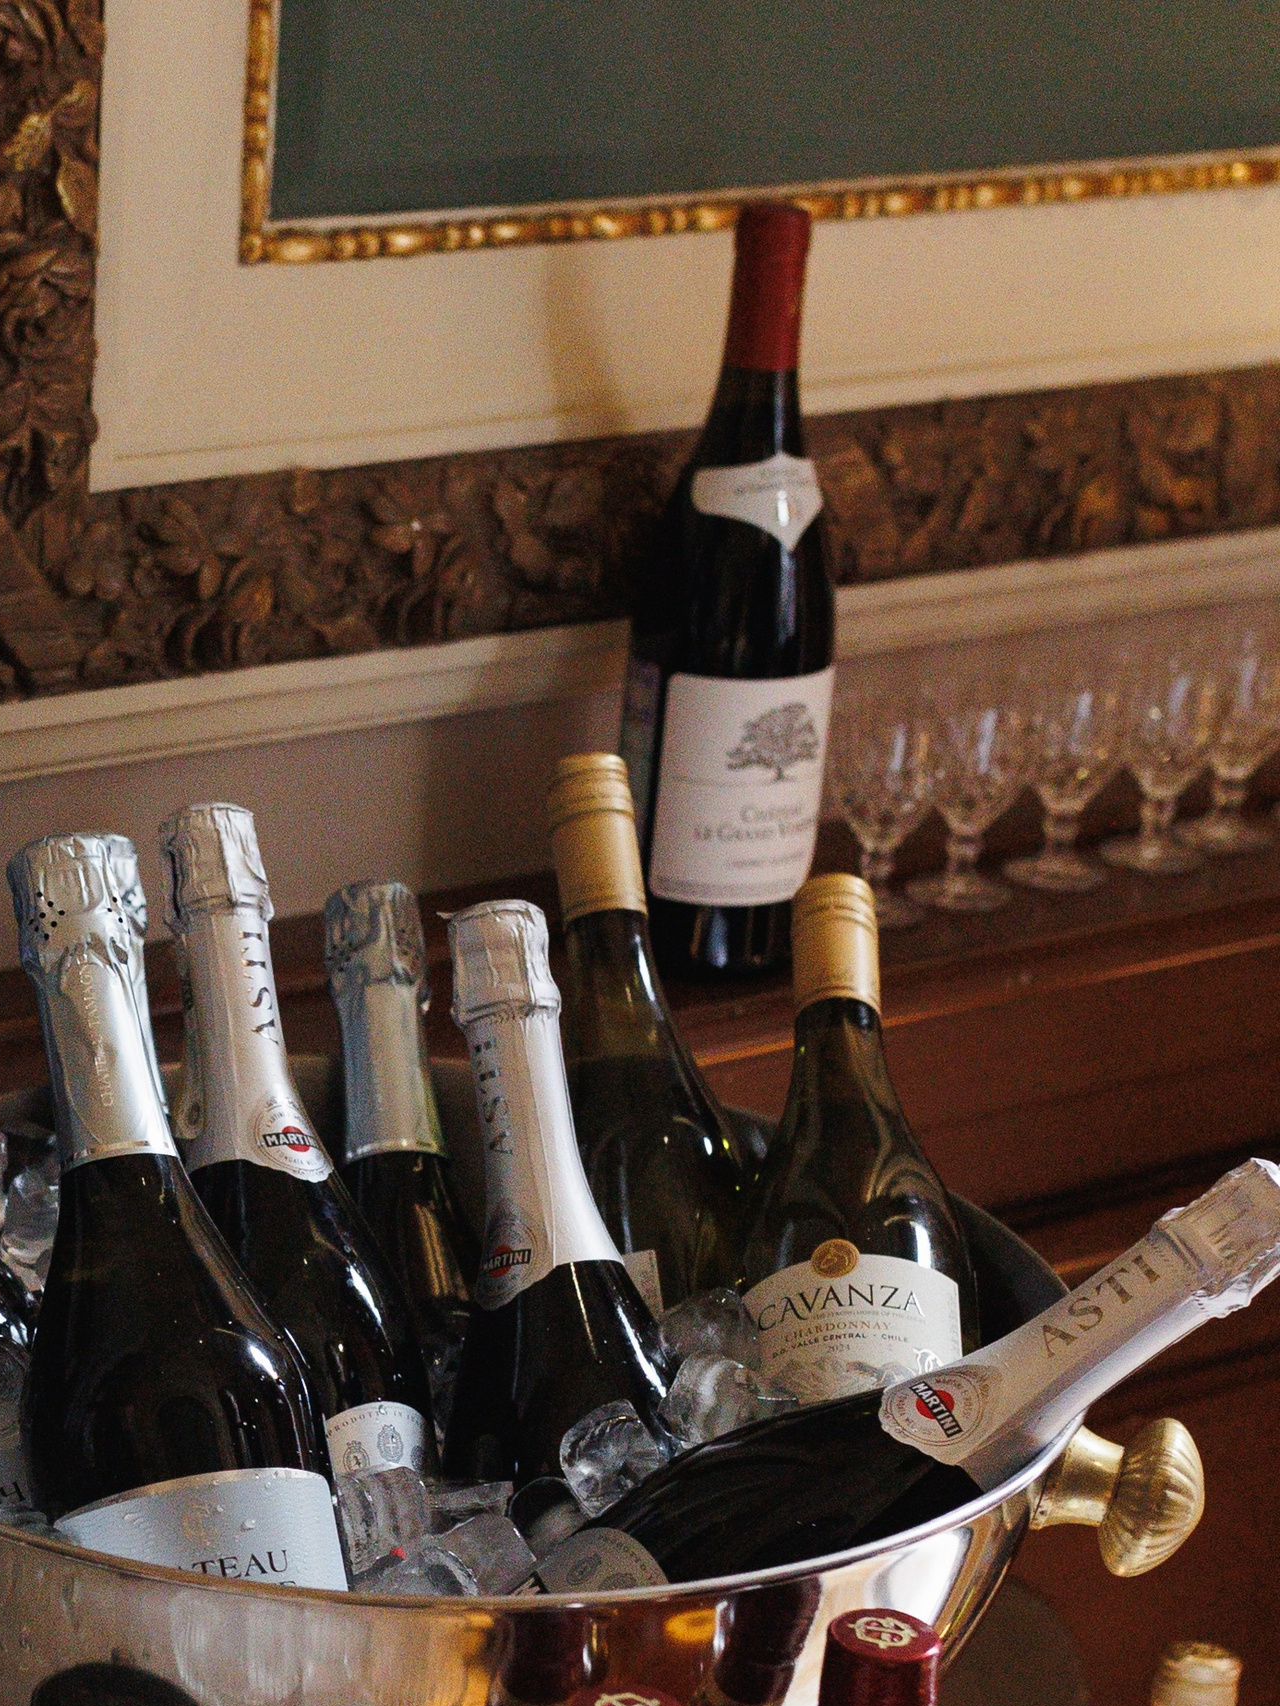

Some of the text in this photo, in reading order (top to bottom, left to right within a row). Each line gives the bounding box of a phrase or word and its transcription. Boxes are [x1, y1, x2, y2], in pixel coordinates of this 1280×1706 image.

[237, 930, 279, 1046] ASTI
[472, 1037, 514, 1155] ASTI
[265, 1133, 318, 1148] MARTIN
[757, 1283, 926, 1332] CAVANZA
[1041, 1253, 1162, 1359] ASTI
[784, 1320, 893, 1344] CHARDONNAY
[822, 1331, 868, 1344] CENTRAL
[880, 1332, 909, 1344] CHILE
[911, 1382, 961, 1436] MARTINI
[176, 1549, 289, 1579] TEAU
